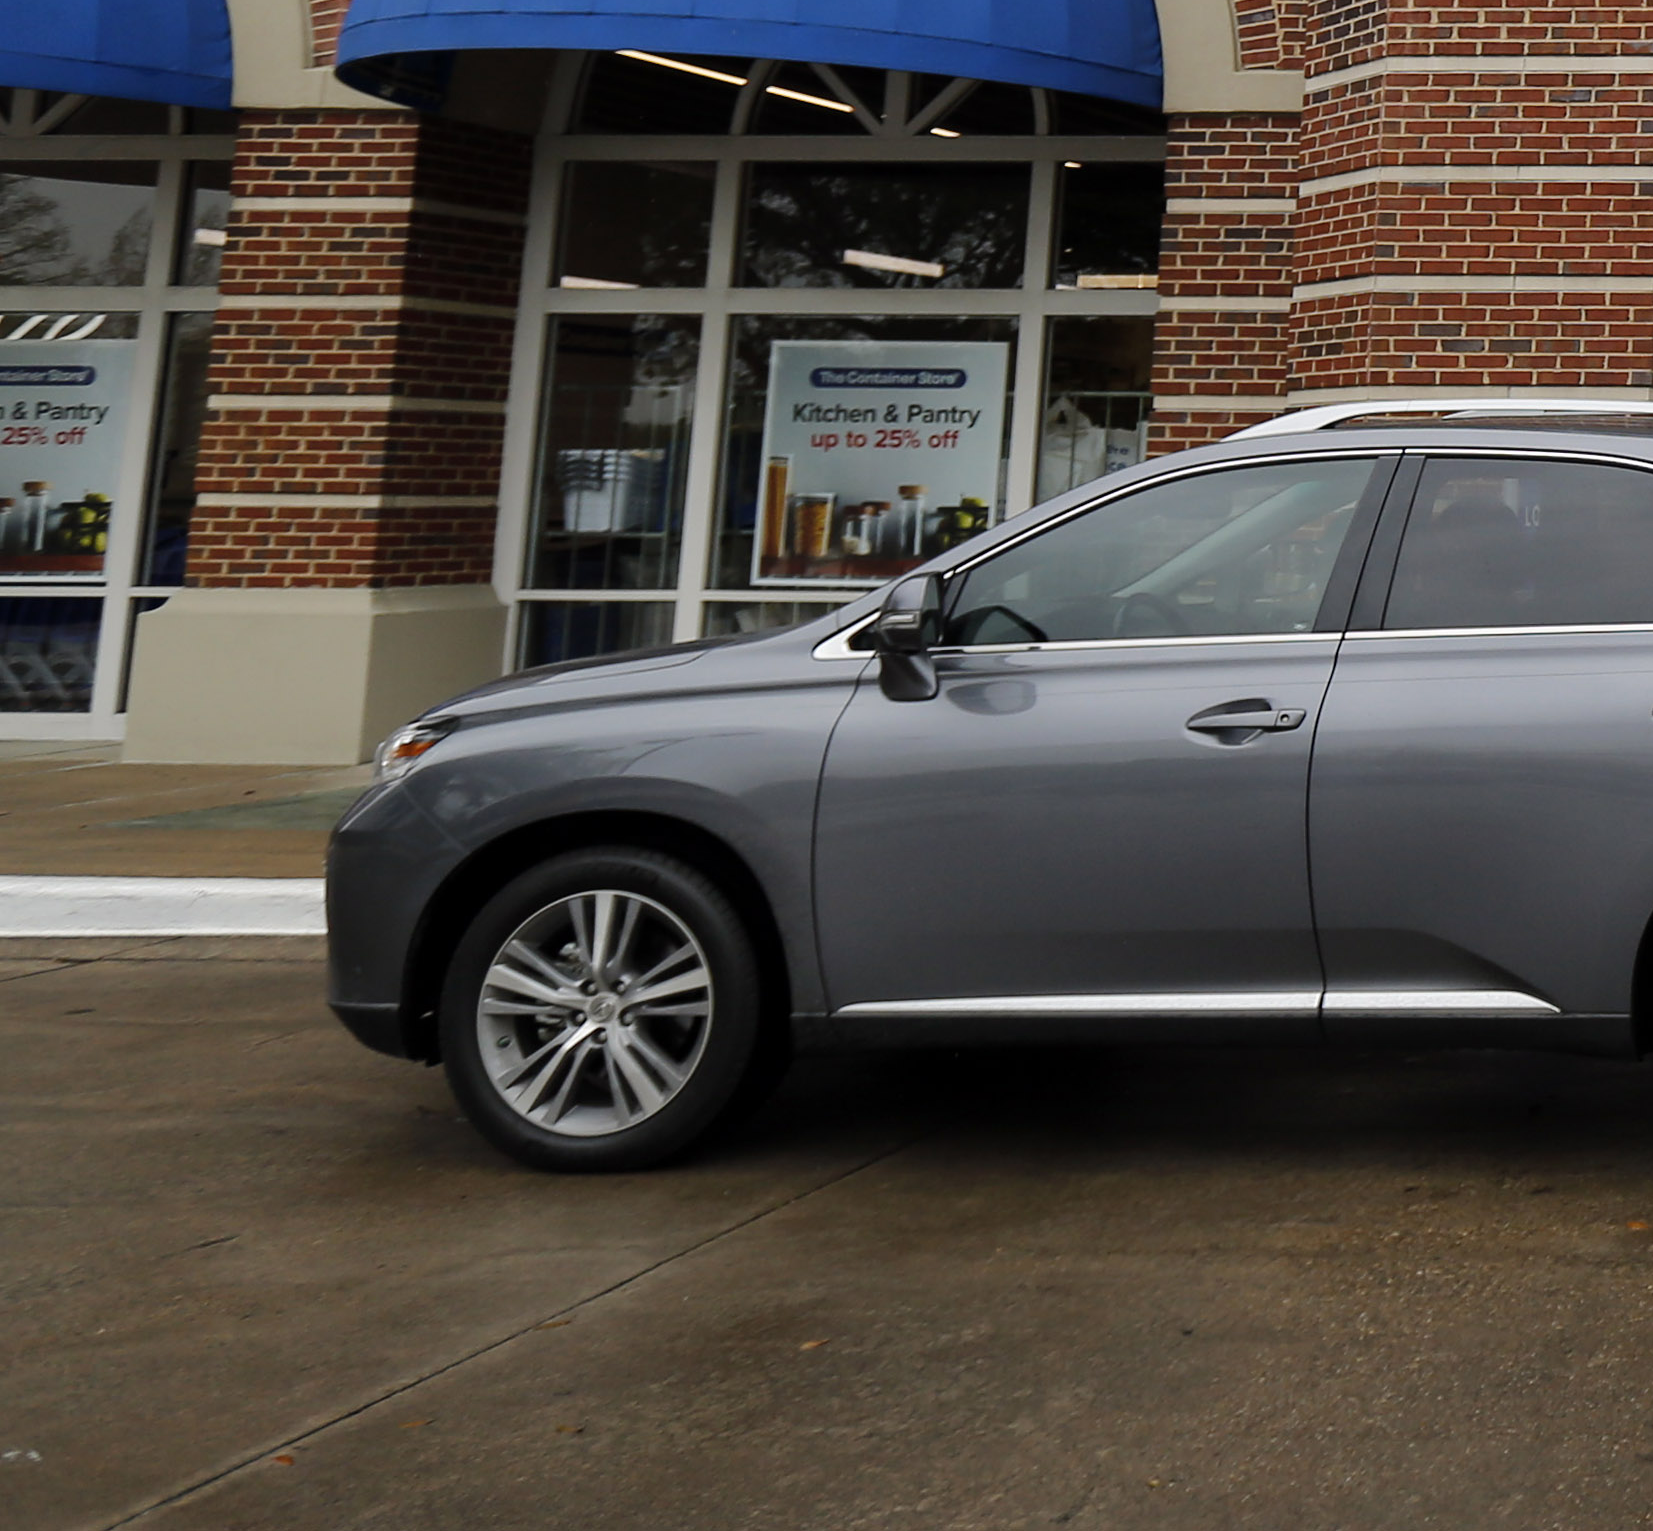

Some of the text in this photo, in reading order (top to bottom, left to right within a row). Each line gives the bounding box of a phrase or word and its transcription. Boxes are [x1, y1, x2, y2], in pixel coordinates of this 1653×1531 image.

[819, 371, 957, 385] The Container Store
[11, 401, 28, 420] &
[35, 401, 110, 425] Pantry
[792, 404, 982, 429] Kitchen & Pantry
[1, 426, 88, 445] 25% off
[811, 429, 960, 452] up to 25% off
